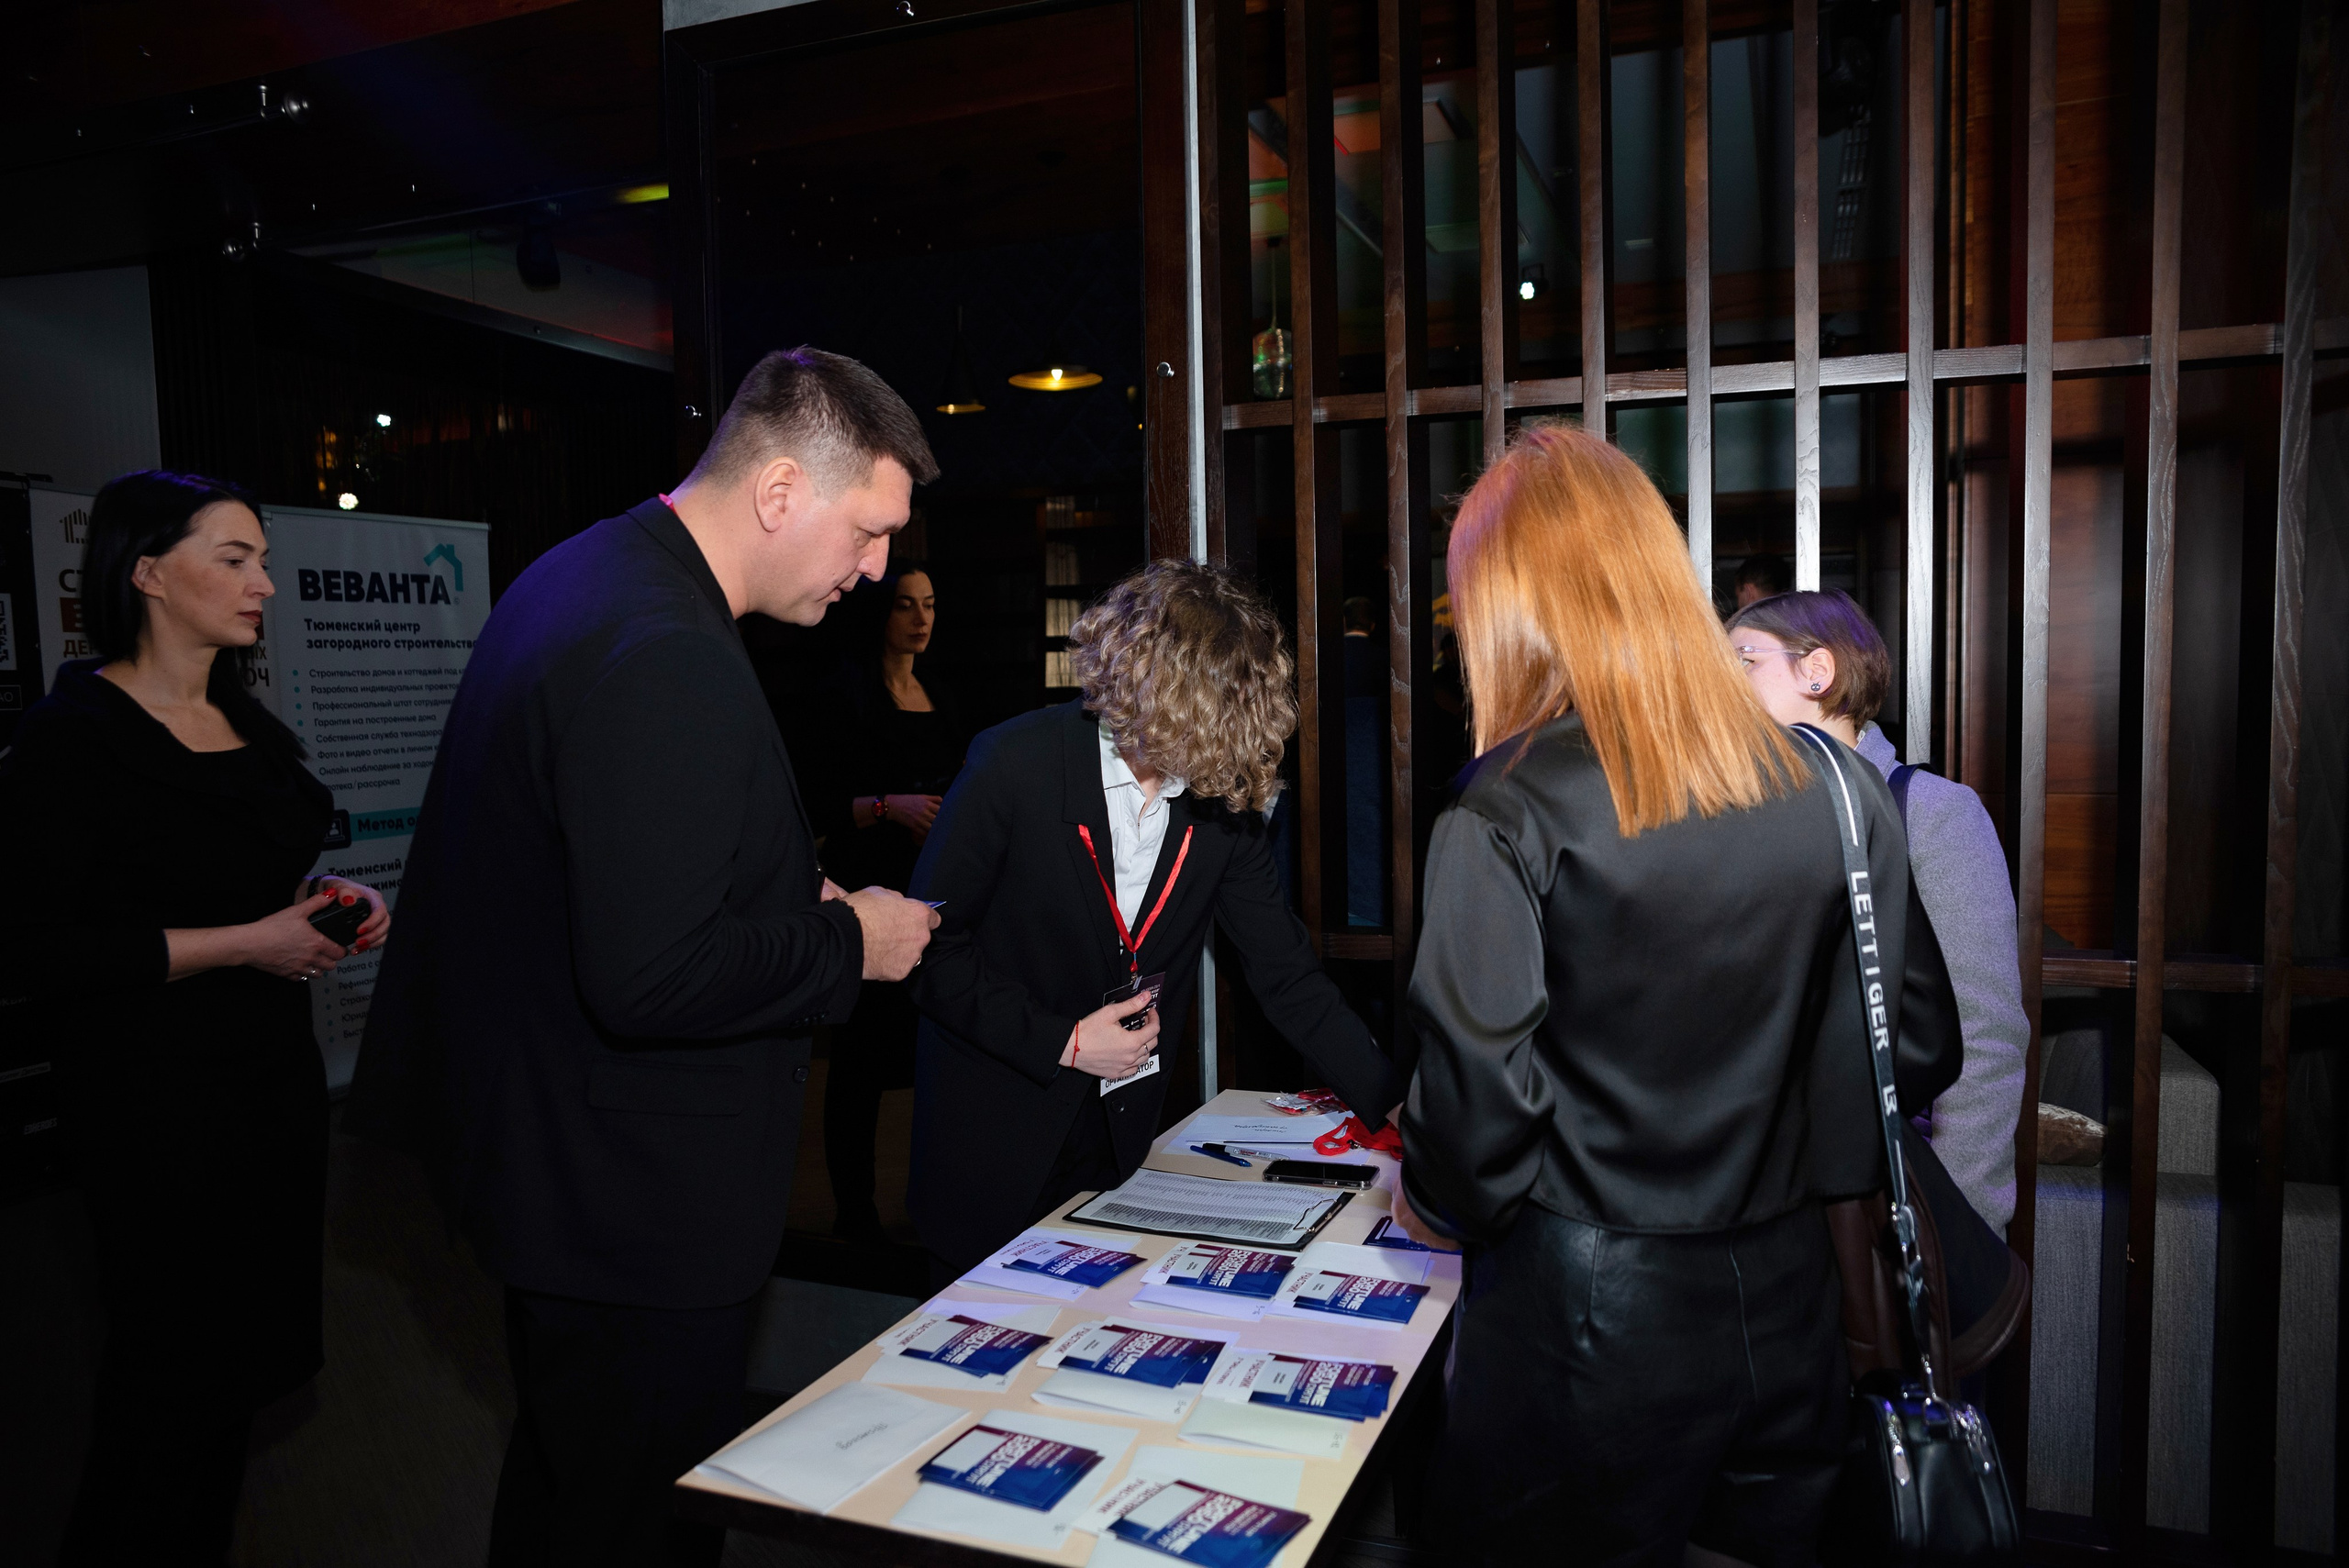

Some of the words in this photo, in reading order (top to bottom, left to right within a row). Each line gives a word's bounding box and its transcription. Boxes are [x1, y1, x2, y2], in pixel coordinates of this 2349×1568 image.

[298, 569, 451, 605] ВЕВАНТА
[304, 618, 381, 632] Тюменский
[384, 621, 420, 634] центр
[306, 639, 391, 651] загородного
[309, 668, 371, 679] Строительство
[373, 669, 396, 678] домов
[405, 667, 442, 677] коттеджей
[444, 668, 458, 677] под
[311, 685, 359, 695] Разработка
[361, 684, 423, 694] индивидуальных
[313, 699, 392, 712] Профессиональный
[394, 699, 412, 707] штат
[414, 698, 454, 707] сотруднико
[315, 717, 351, 728] Гарантия
[353, 717, 363, 726] на
[366, 715, 417, 725] построенные
[418, 714, 436, 722] дома
[316, 733, 369, 744] Собственная
[371, 730, 398, 740] служба
[400, 728, 442, 739] технадзора
[317, 750, 338, 760] Фото
[346, 749, 371, 758] видео
[373, 746, 399, 755] отчеты
[407, 744, 433, 753] личном
[319, 765, 350, 776] Онлайн
[351, 762, 401, 773] наблюдение
[403, 762, 411, 770] за
[358, 817, 404, 832] Метод
[328, 859, 402, 877] Тюменский
[337, 962, 366, 974] Работа
[1850, 870, 1889, 1051] LETTIGER
[339, 977, 378, 991] Рефинанс
[340, 994, 372, 1006] Страхо
[1053, 1249, 1108, 1275] FORTUNE
[1219, 1257, 1249, 1287] FORTUNE
[1347, 1277, 1382, 1311] FORTUNE
[951, 1326, 1008, 1364] FORTUNE
[1113, 1333, 1164, 1374] FORTUNE
[1310, 1362, 1344, 1407] FORTUNE
[975, 1436, 1042, 1488] FORTUNE
